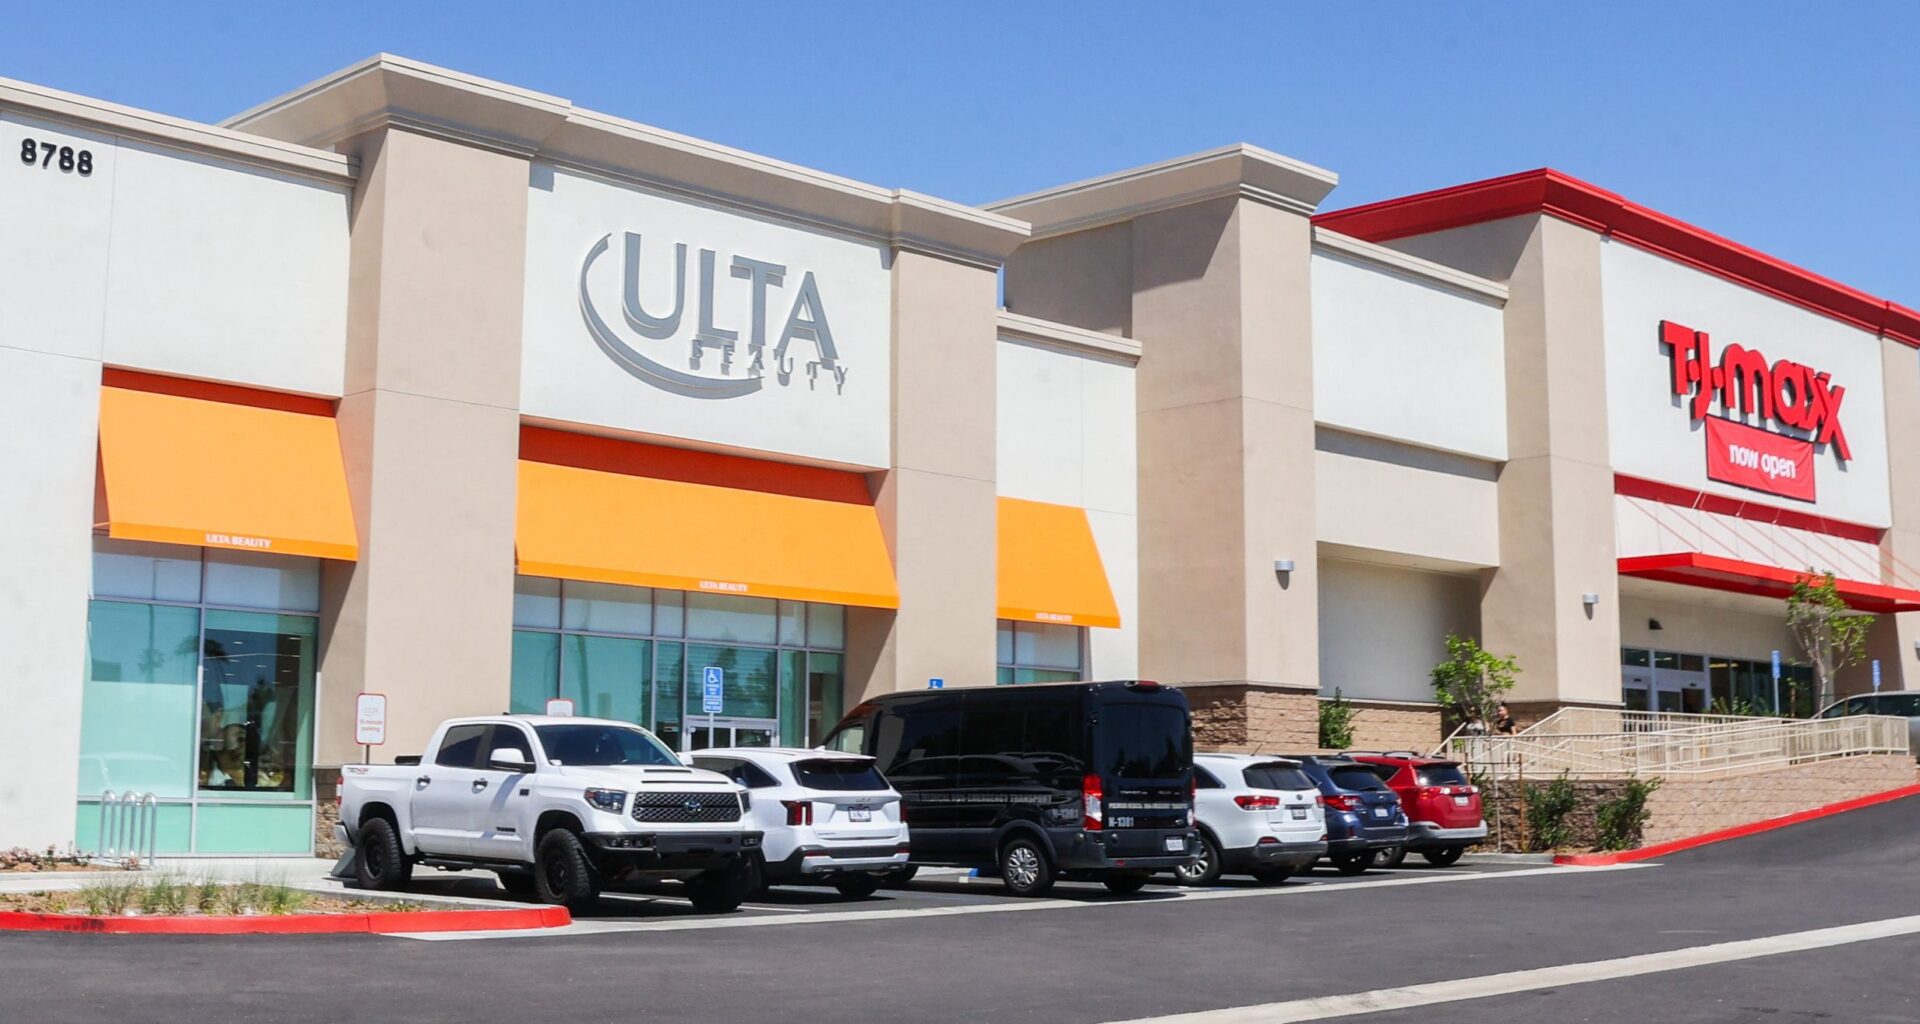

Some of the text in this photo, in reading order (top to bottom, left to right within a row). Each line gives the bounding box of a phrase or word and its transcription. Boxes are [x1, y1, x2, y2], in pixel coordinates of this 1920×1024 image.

[21, 138, 93, 175] 8788
[622, 231, 838, 360] ULTA
[690, 339, 848, 386] BEAUTY
[1729, 444, 1797, 479] now open
[205, 533, 272, 548] ULTA BEAUTY
[1108, 817, 1134, 827] N-1381
